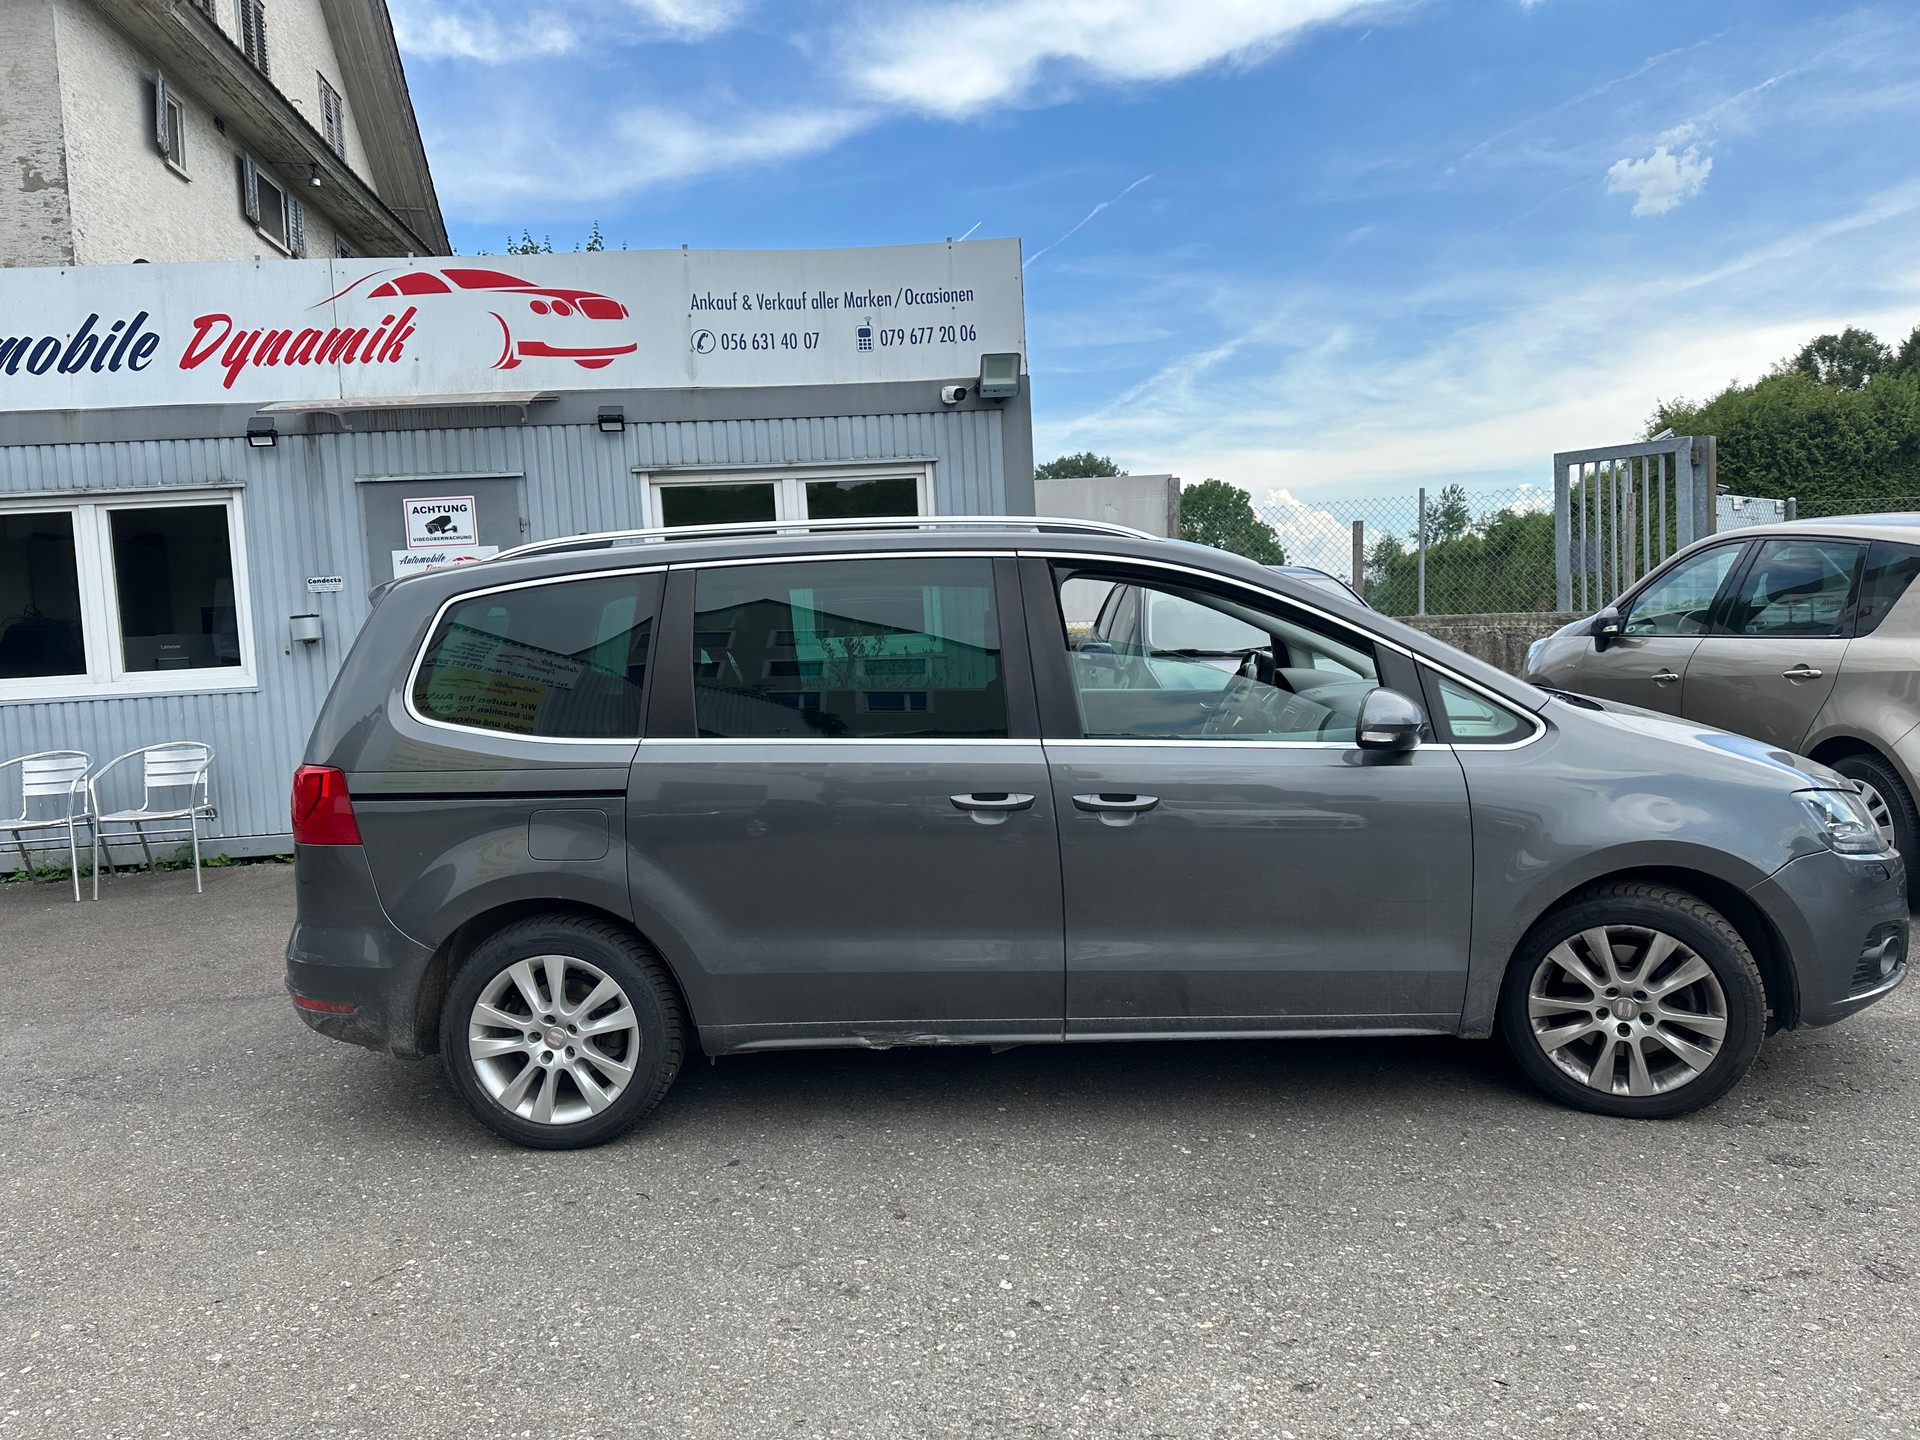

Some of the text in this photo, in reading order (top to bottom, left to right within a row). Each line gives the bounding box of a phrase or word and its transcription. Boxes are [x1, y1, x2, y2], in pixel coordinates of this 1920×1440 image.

[690, 292, 738, 311] Ankauf
[742, 295, 753, 311] &
[756, 291, 807, 311] Verkauf
[811, 291, 840, 310] aller
[721, 332, 820, 351] 056 631 40 07
[880, 325, 977, 347] 079 677 20 06
[179, 306, 418, 390] Dynamik
[412, 504, 468, 514] ACHTUNG
[413, 534, 472, 542] VIDEOÜBERWACHUNG
[400, 553, 446, 565] Automobile
